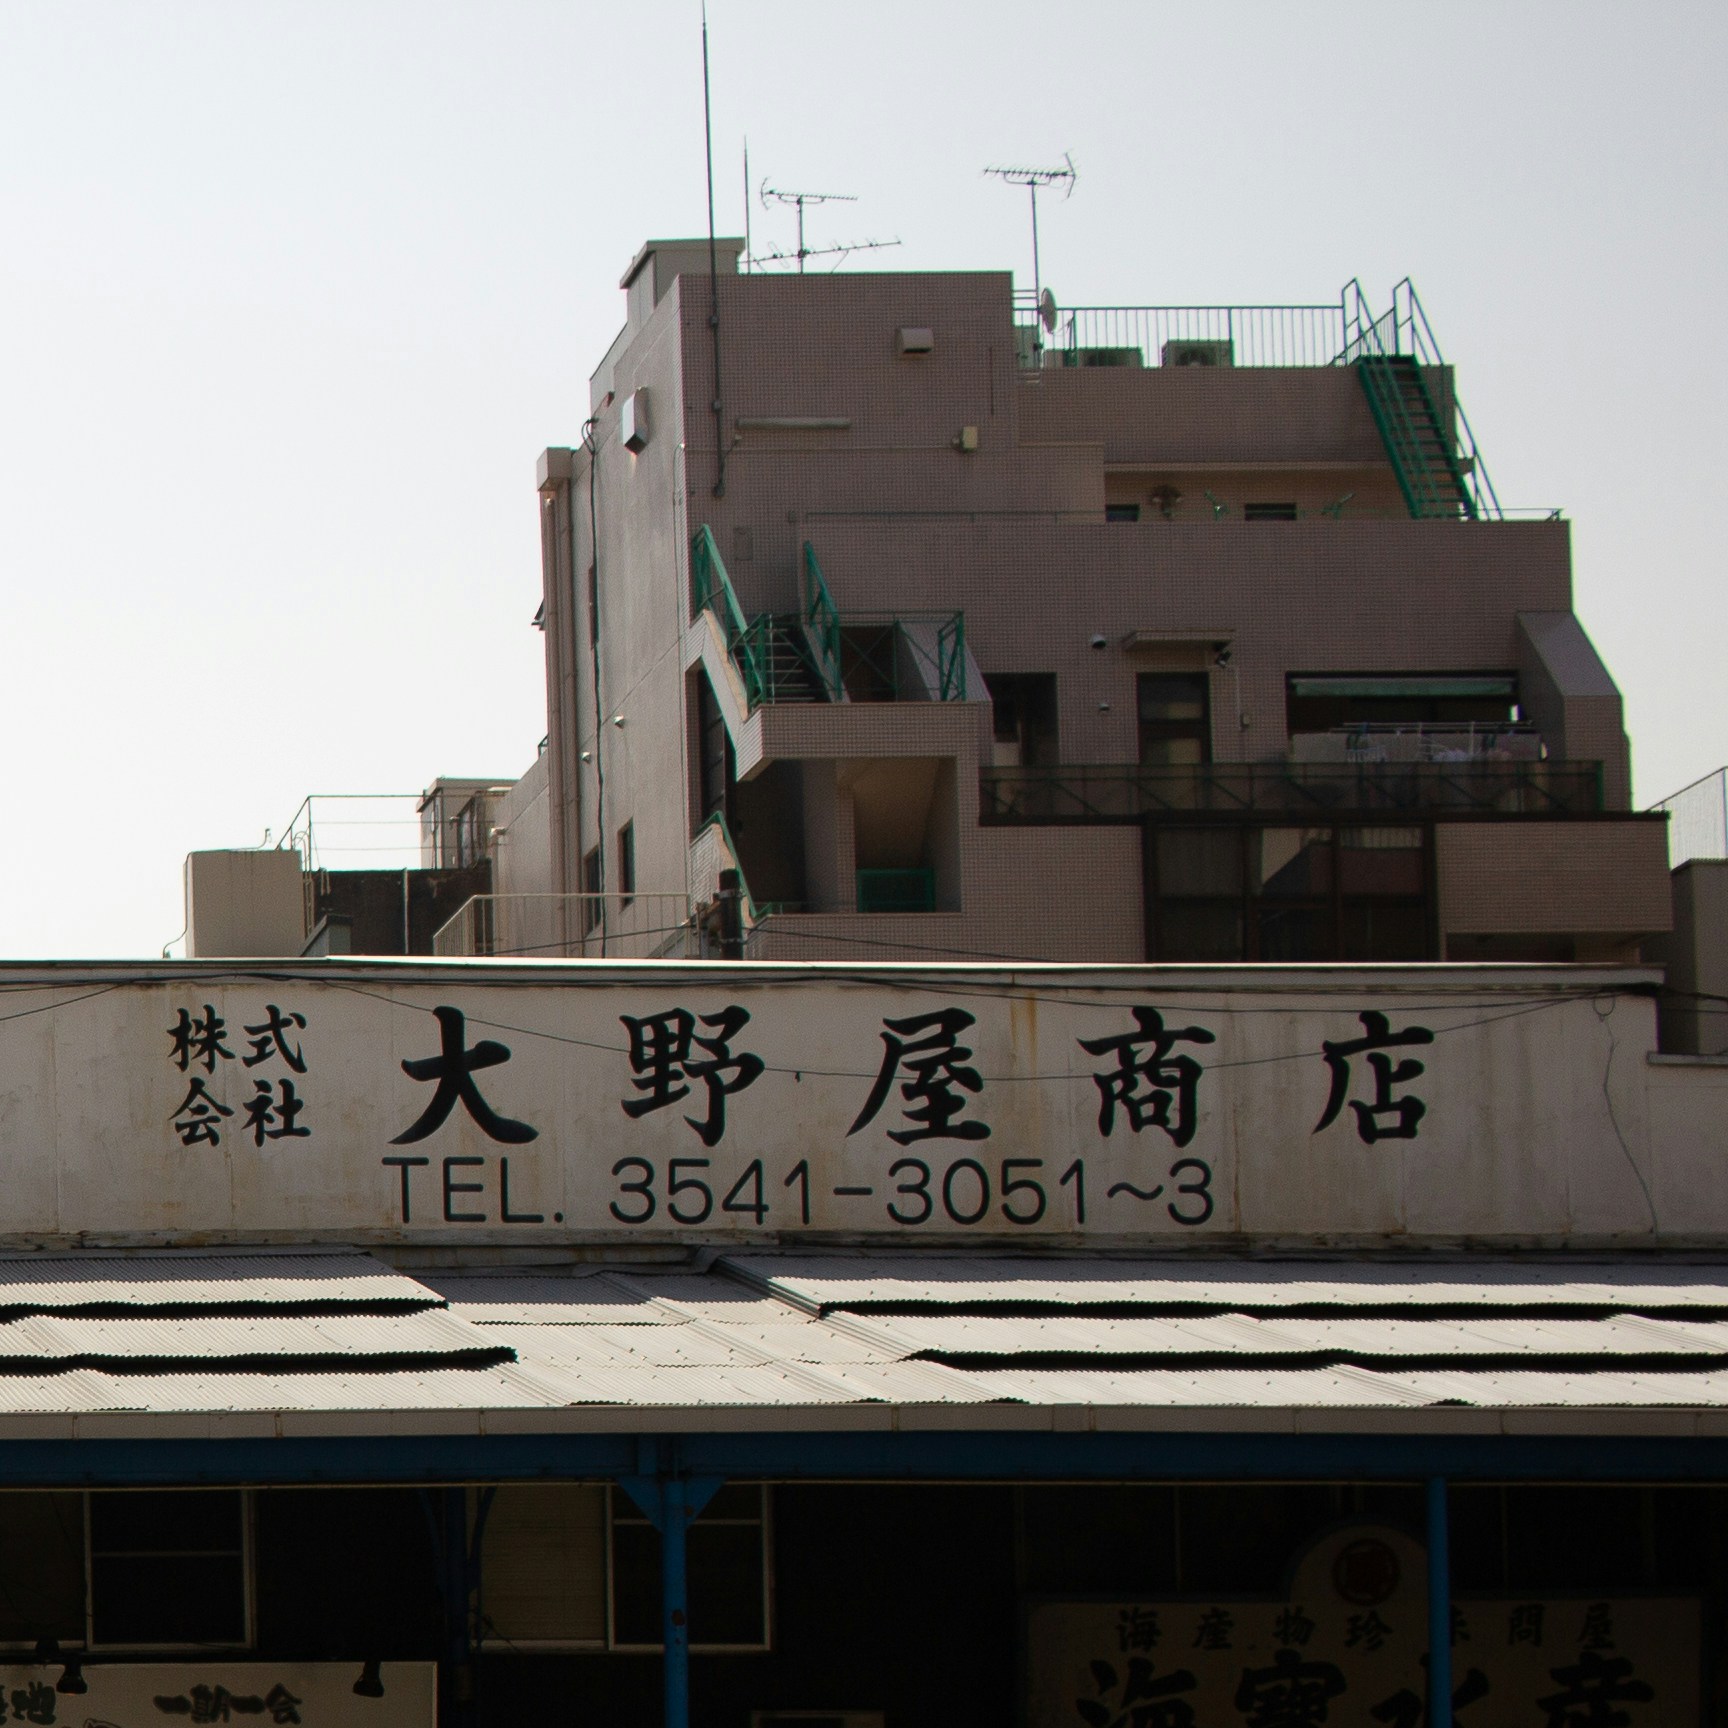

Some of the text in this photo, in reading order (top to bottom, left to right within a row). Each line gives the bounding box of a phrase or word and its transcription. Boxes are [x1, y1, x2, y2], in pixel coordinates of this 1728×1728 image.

[166, 1004, 308, 1074] 株式
[390, 1003, 1435, 1148] 大野屋商店
[172, 1078, 312, 1148] 会社
[380, 1155, 564, 1224] TEL.
[154, 1683, 302, 1724] 一期一会
